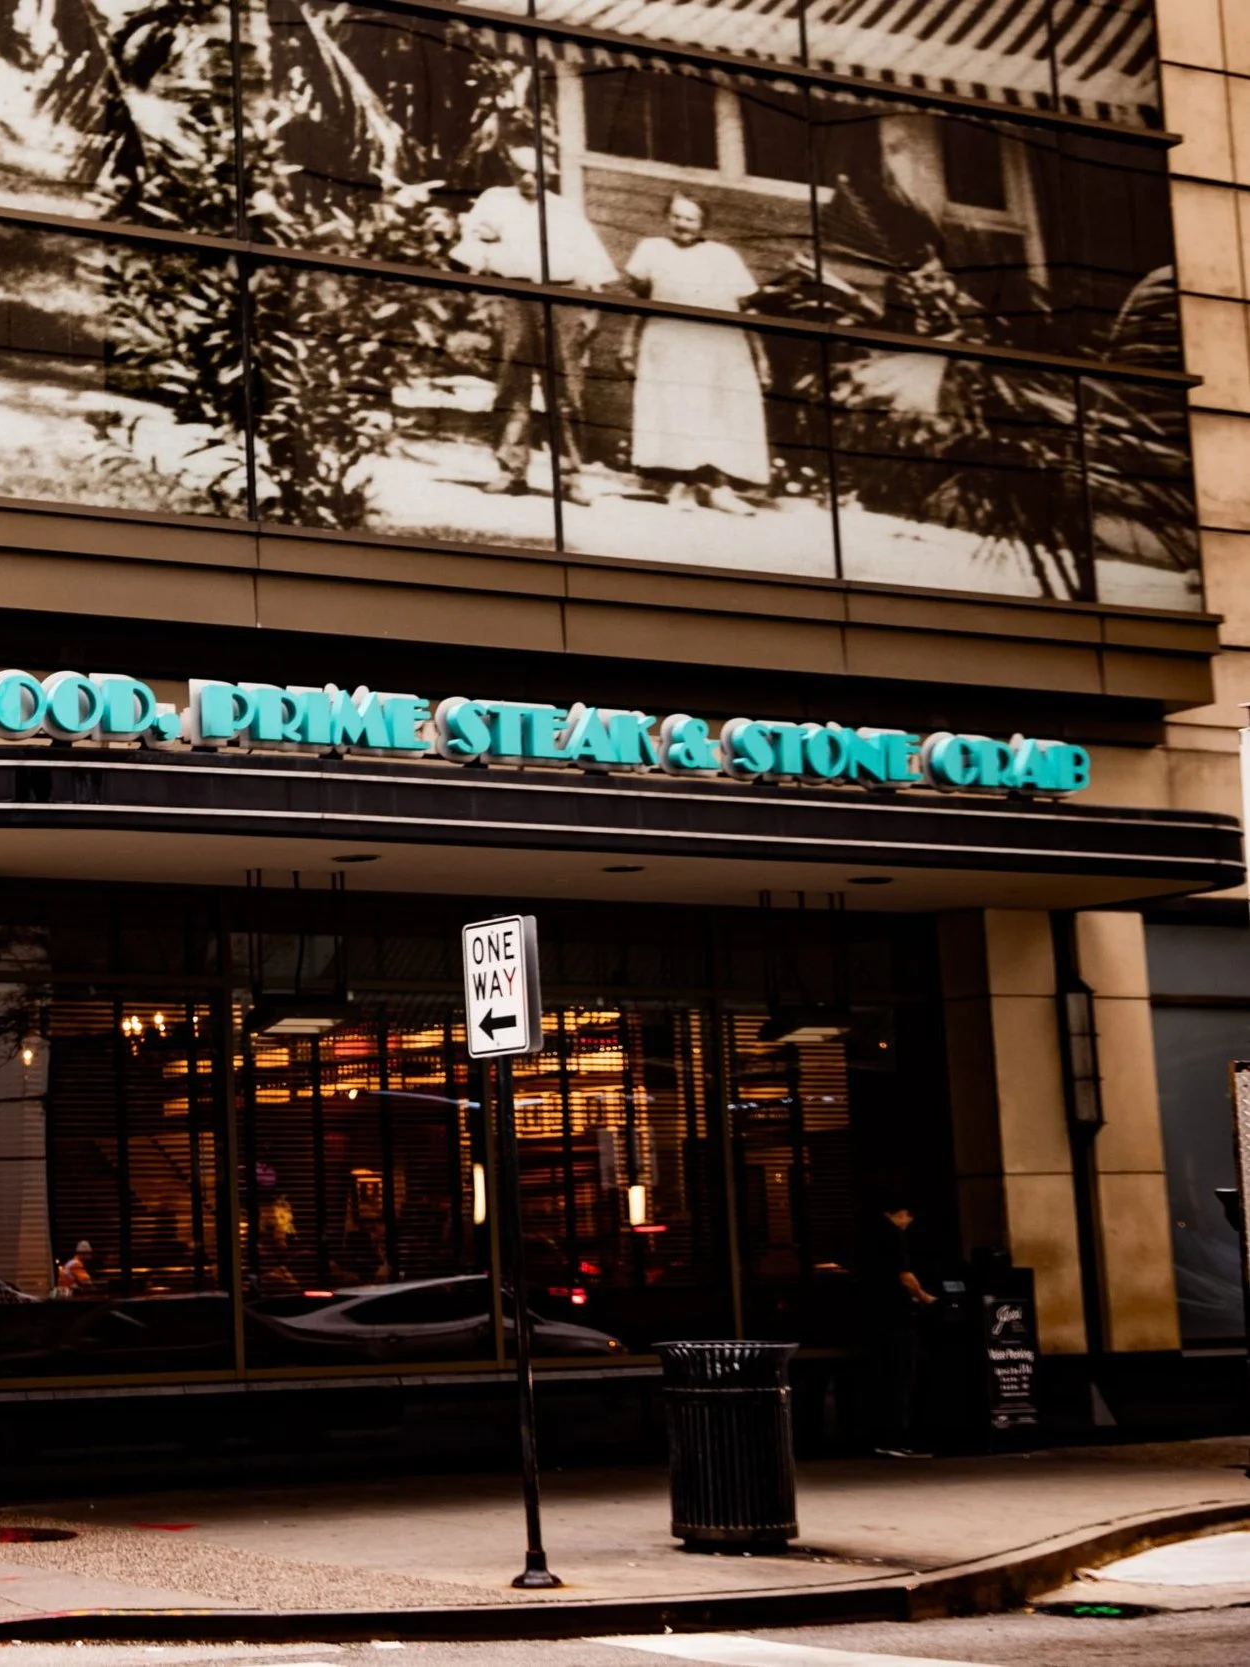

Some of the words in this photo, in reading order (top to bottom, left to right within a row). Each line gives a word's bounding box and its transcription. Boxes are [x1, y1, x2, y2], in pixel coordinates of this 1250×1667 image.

[198, 684, 431, 750] PRIME
[445, 701, 658, 765] STEAK
[666, 717, 721, 770] &
[730, 721, 923, 783] STONE
[930, 736, 1090, 792] CRAB
[472, 930, 515, 965] ONE
[473, 966, 517, 1001] WAY
